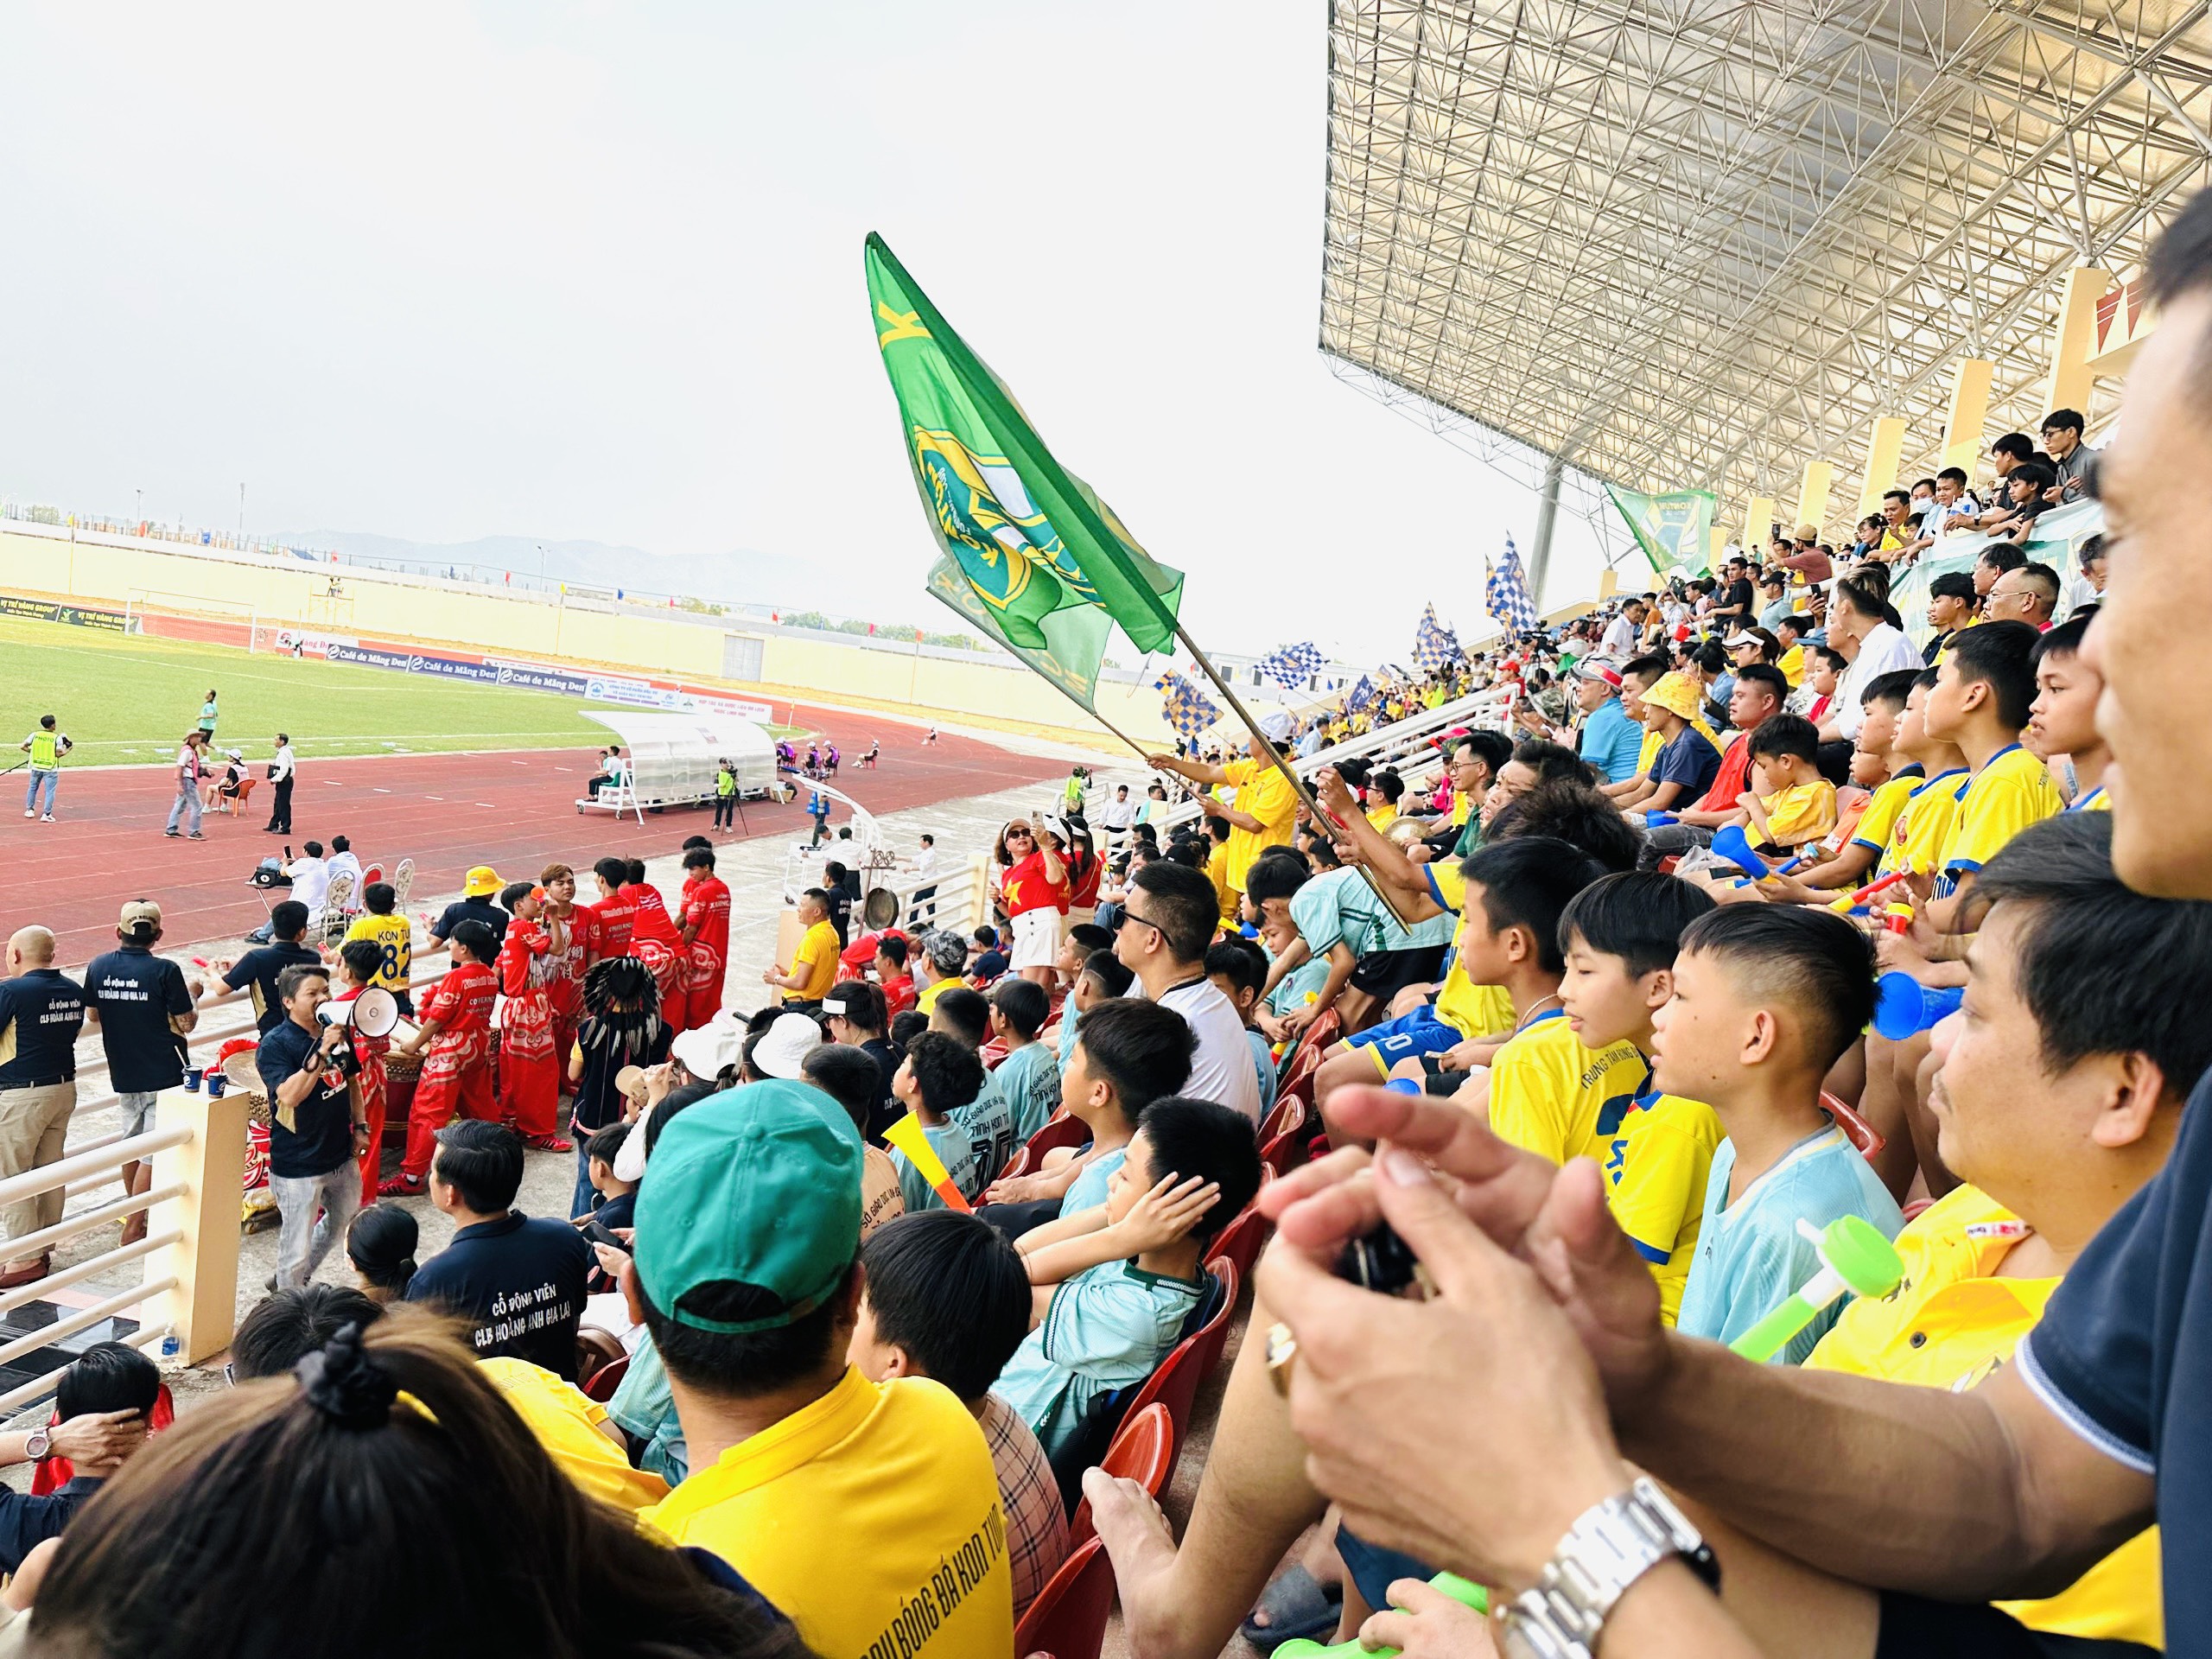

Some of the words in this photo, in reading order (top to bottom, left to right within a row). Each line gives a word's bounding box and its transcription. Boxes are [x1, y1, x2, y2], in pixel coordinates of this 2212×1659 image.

[340, 649, 357, 660] Café
[357, 652, 367, 662] de
[367, 654, 391, 667] Măng
[391, 658, 407, 668] Đen
[424, 661, 443, 672] Café
[443, 664, 454, 674] de
[454, 664, 479, 678] Măng
[479, 669, 497, 680] Đen
[512, 673, 532, 684] Café
[532, 676, 543, 685] de
[543, 677, 568, 690] Măng
[568, 681, 586, 692] Đen
[378, 931, 398, 942] KON
[400, 929, 410, 940] TU
[381, 942, 411, 980] 82
[492, 1292, 507, 1316] CỔ
[508, 1291, 534, 1312] ĐỘNG
[533, 1282, 557, 1303] VIÊN
[474, 1327, 494, 1348] CLB
[495, 1316, 527, 1343] HOÀNG
[527, 1310, 544, 1332] ANH
[545, 1306, 559, 1326] GIA
[559, 1300, 571, 1321] LAI
[892, 1596, 941, 1659] BÓNG
[931, 1554, 963, 1618] ĐÁ
[952, 1533, 990, 1597] KON
